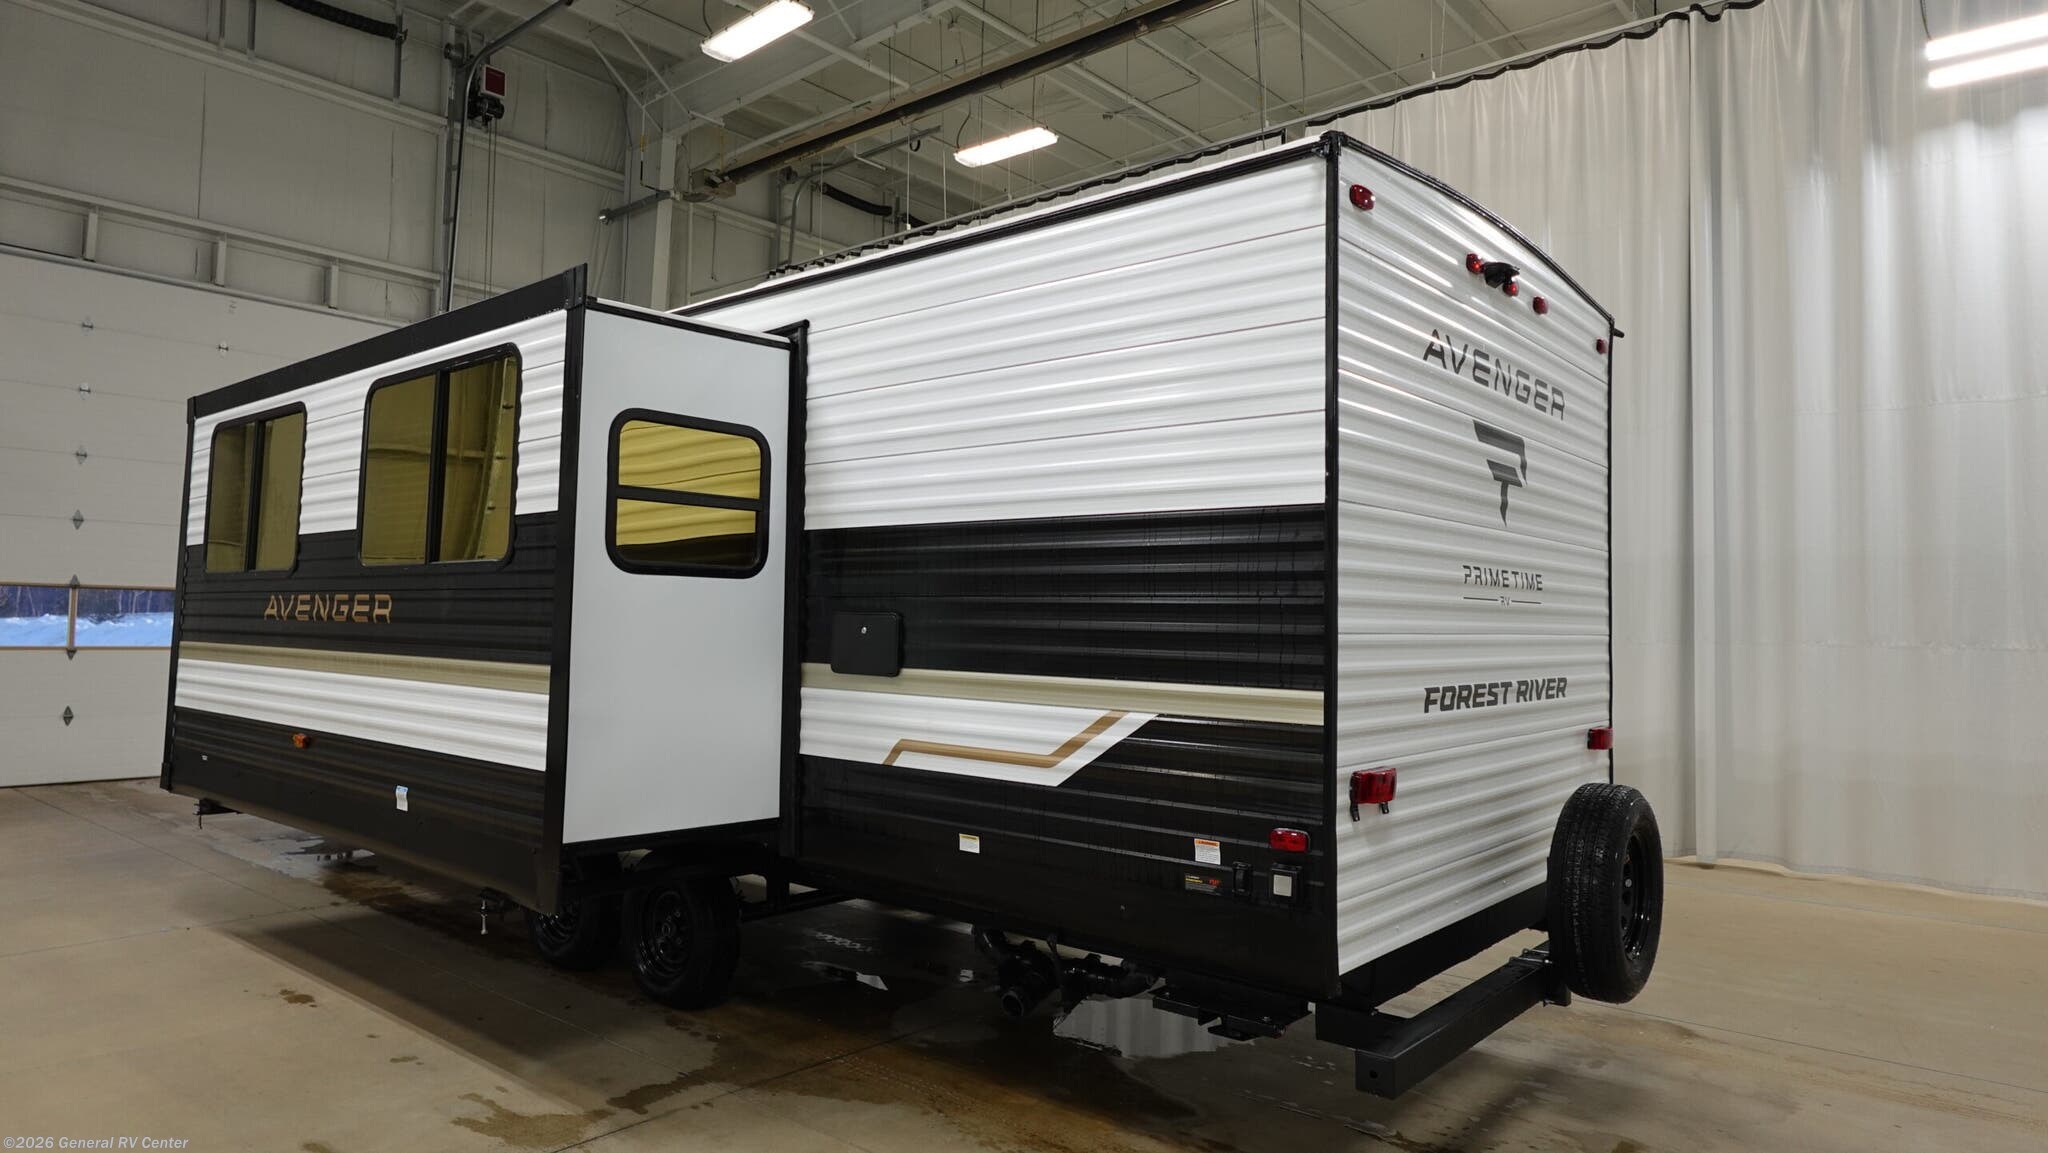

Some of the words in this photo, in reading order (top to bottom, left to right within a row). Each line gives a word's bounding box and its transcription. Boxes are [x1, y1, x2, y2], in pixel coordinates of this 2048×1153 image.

[1423, 329, 1565, 420] AVENGER
[1463, 565, 1543, 591] PRIMETIME
[264, 594, 393, 624] AVENGER
[1500, 596, 1511, 606] RV
[1424, 681, 1513, 713] FOREST
[1516, 677, 1568, 703] RIVER
